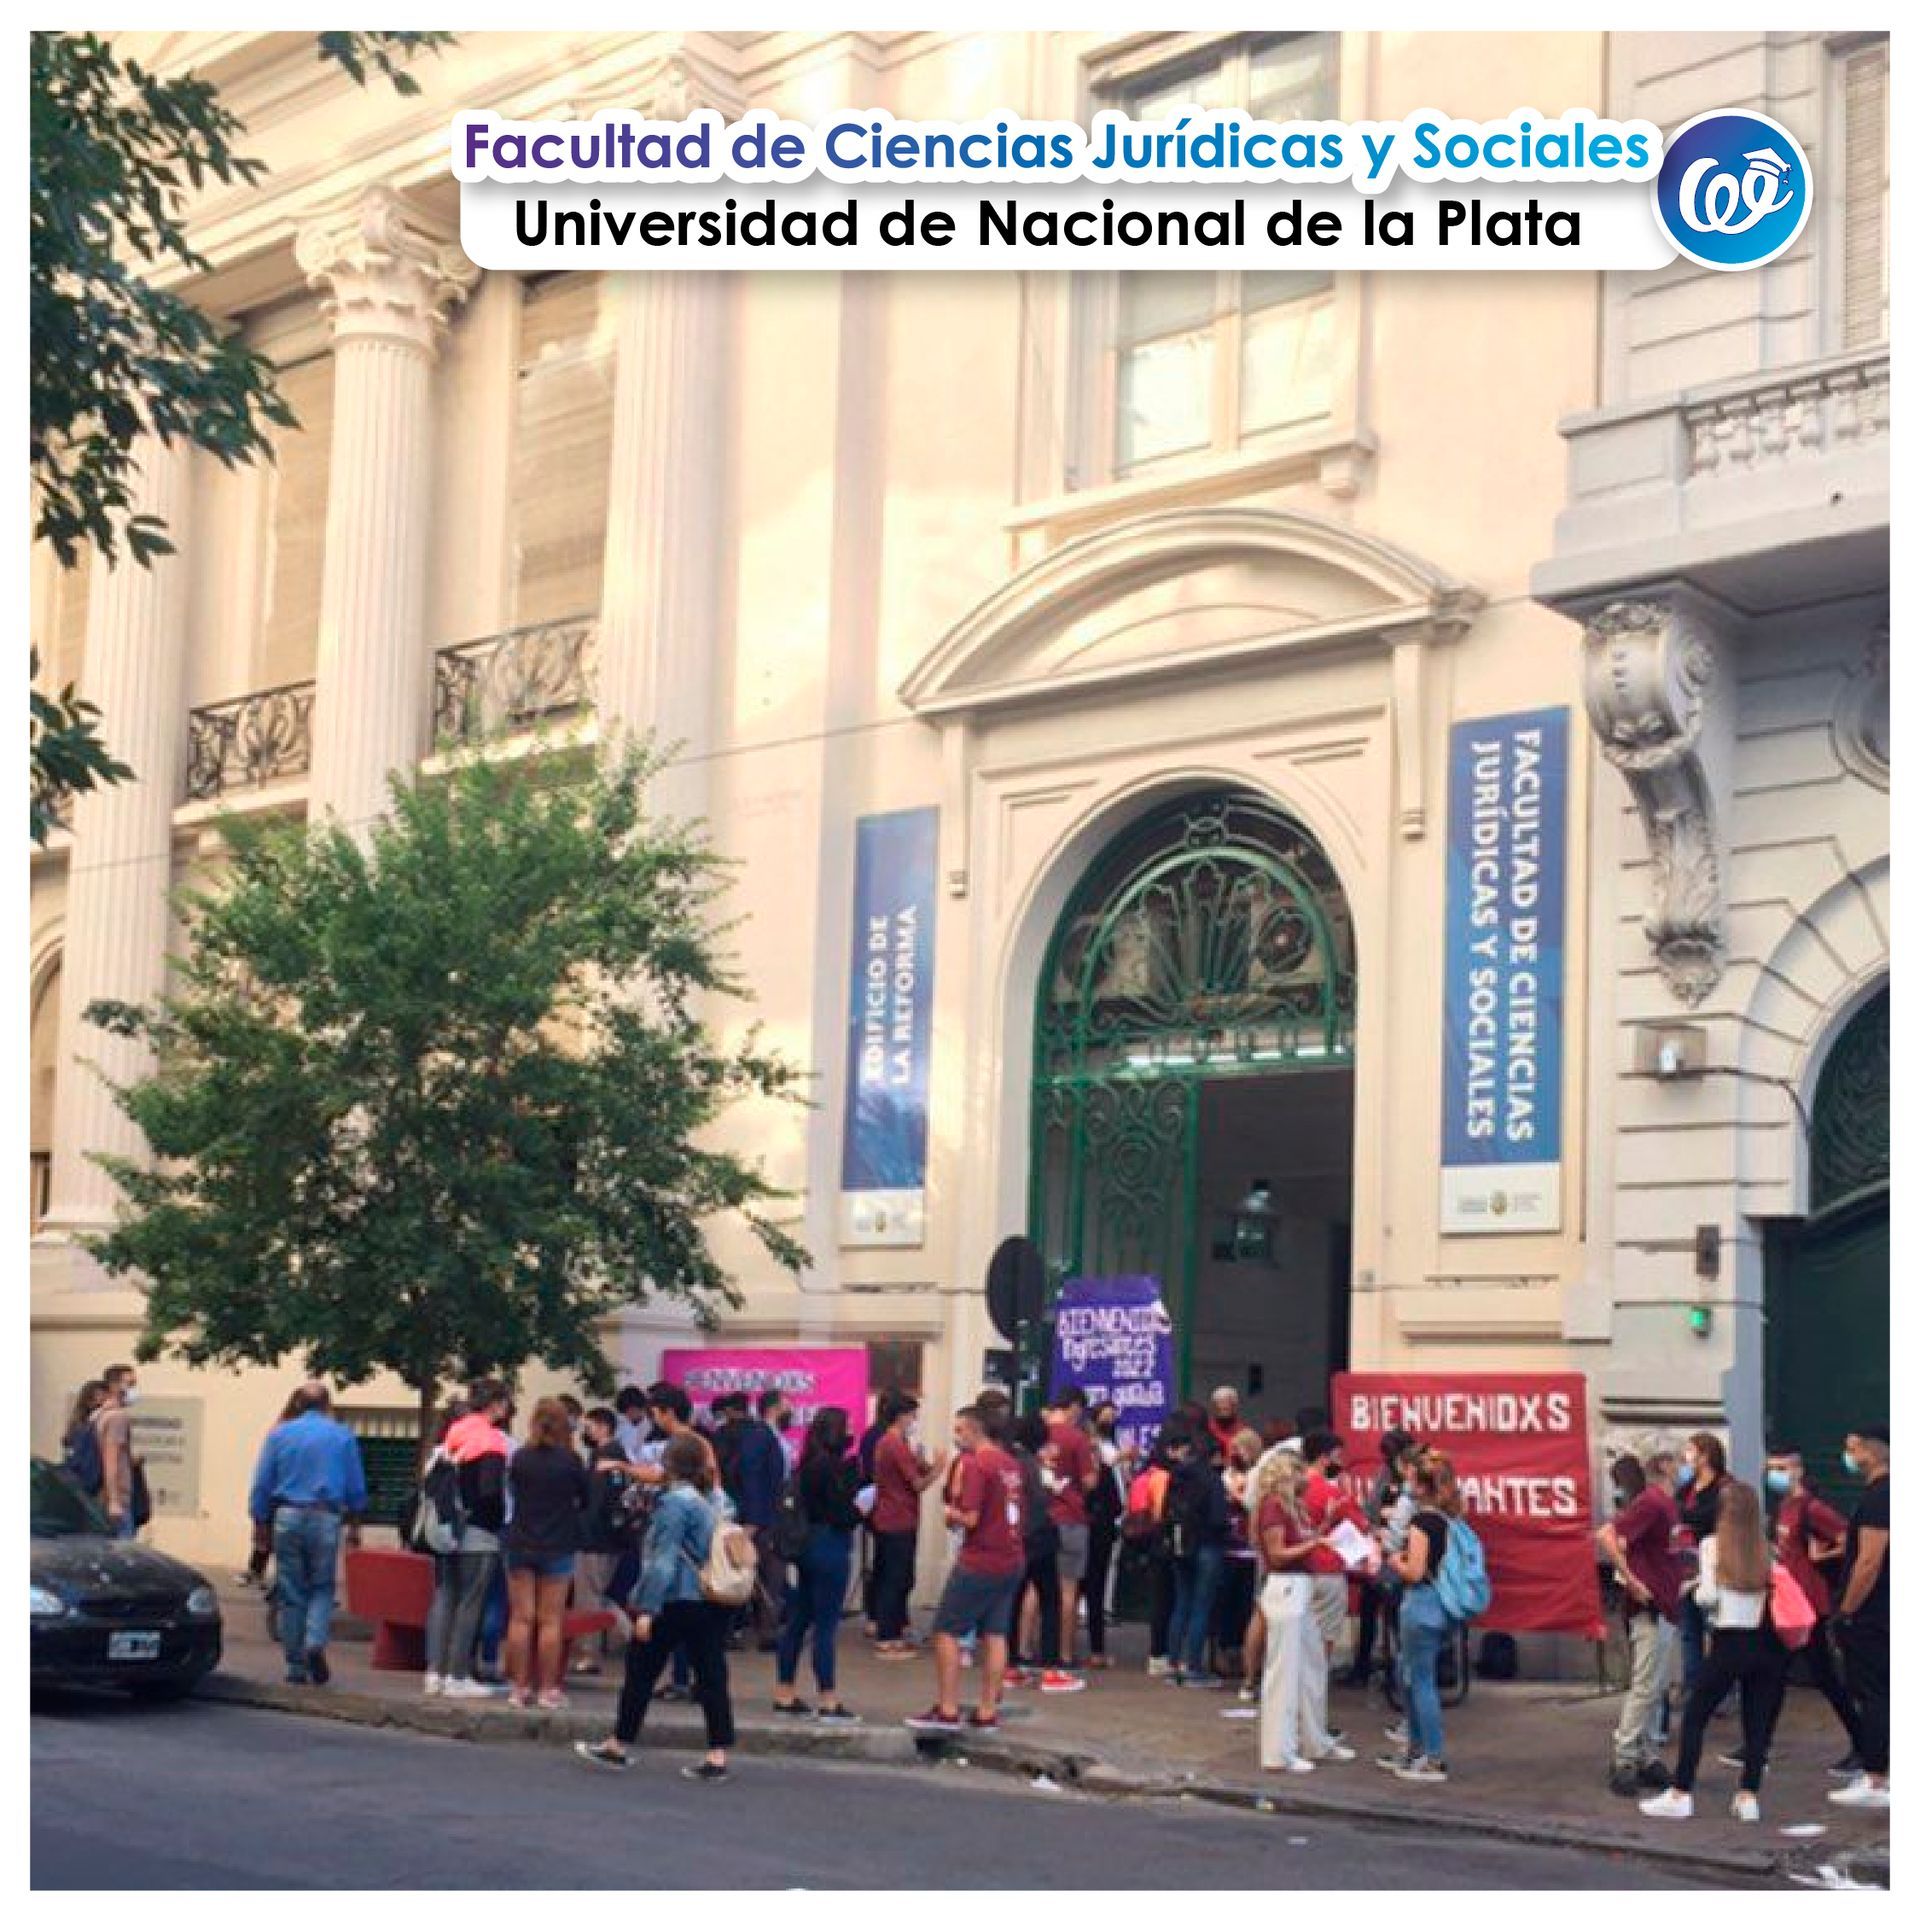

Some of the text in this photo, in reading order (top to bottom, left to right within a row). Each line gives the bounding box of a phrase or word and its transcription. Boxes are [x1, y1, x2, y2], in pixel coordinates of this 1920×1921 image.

[1467, 739, 1507, 1139] JURÍDICAS Y SOCIALES
[1504, 727, 1542, 1142] FACULTAD DE CIENCIAS
